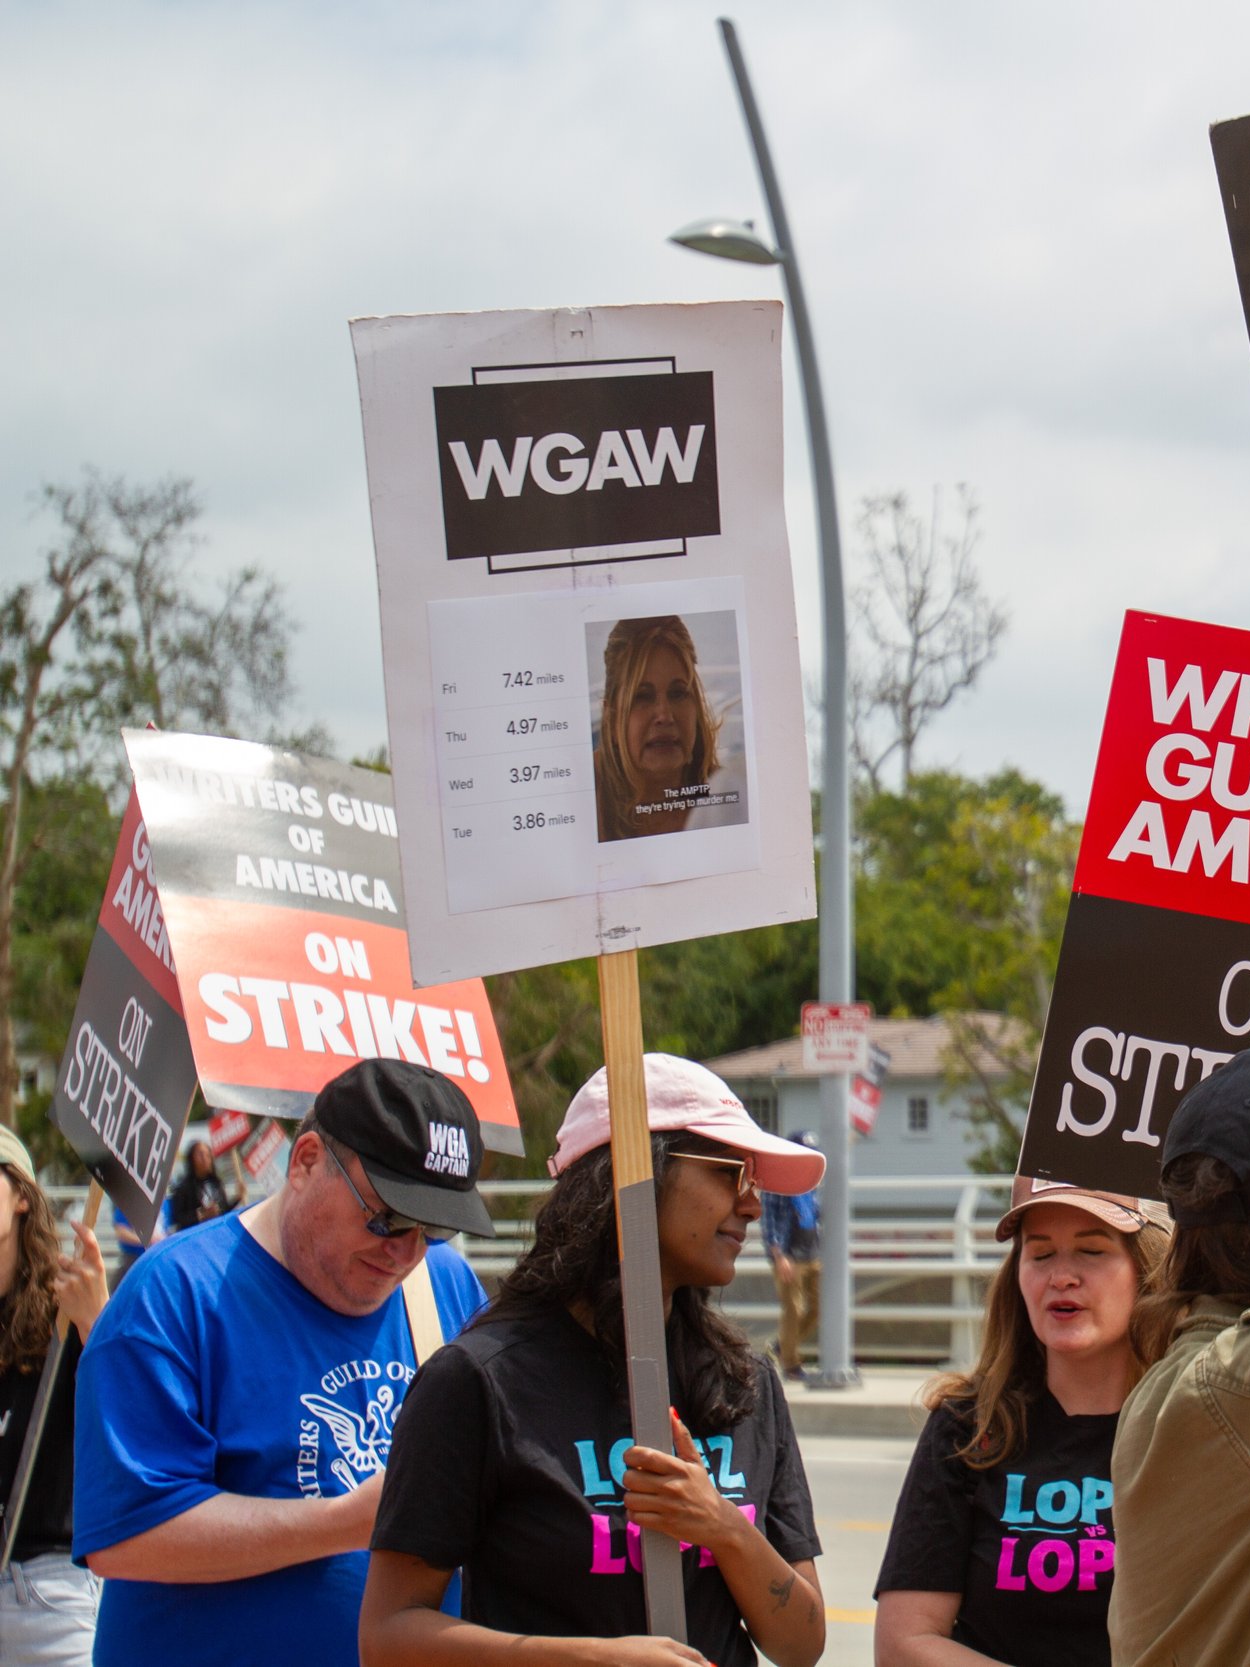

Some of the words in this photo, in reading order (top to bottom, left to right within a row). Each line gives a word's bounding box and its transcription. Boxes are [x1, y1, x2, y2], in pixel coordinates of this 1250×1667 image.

[448, 424, 706, 501] WGAW
[442, 683, 457, 694] Fri
[502, 671, 533, 688] 7.42
[536, 673, 565, 685] miles
[445, 731, 467, 742] Thu
[506, 718, 537, 735] 4.97
[541, 720, 568, 732] miles
[449, 778, 474, 791] Wed
[509, 765, 541, 783] 3.97
[543, 767, 571, 780] miles
[664, 788, 679, 798] The
[680, 784, 710, 797] AMPTP
[452, 828, 472, 839] Tue
[512, 812, 546, 831] 3.86
[548, 814, 575, 826] miles
[663, 800, 686, 812] trying
[686, 799, 696, 807] to
[288, 825, 325, 855] OF
[236, 854, 398, 914] AMERICA
[112, 865, 176, 975] AMER
[305, 933, 371, 981] ON
[118, 995, 153, 1071] ON
[199, 972, 490, 1084] STRIKE!
[64, 1021, 173, 1204] STRIKE
[424, 1152, 469, 1177] CAPTAIN
[429, 1122, 469, 1159] WGA
[297, 1419, 323, 1499] ITERS
[321, 1360, 382, 1395] GUILD
[1000, 1474, 1114, 1525] LOP
[995, 1537, 1116, 1592] LOP
